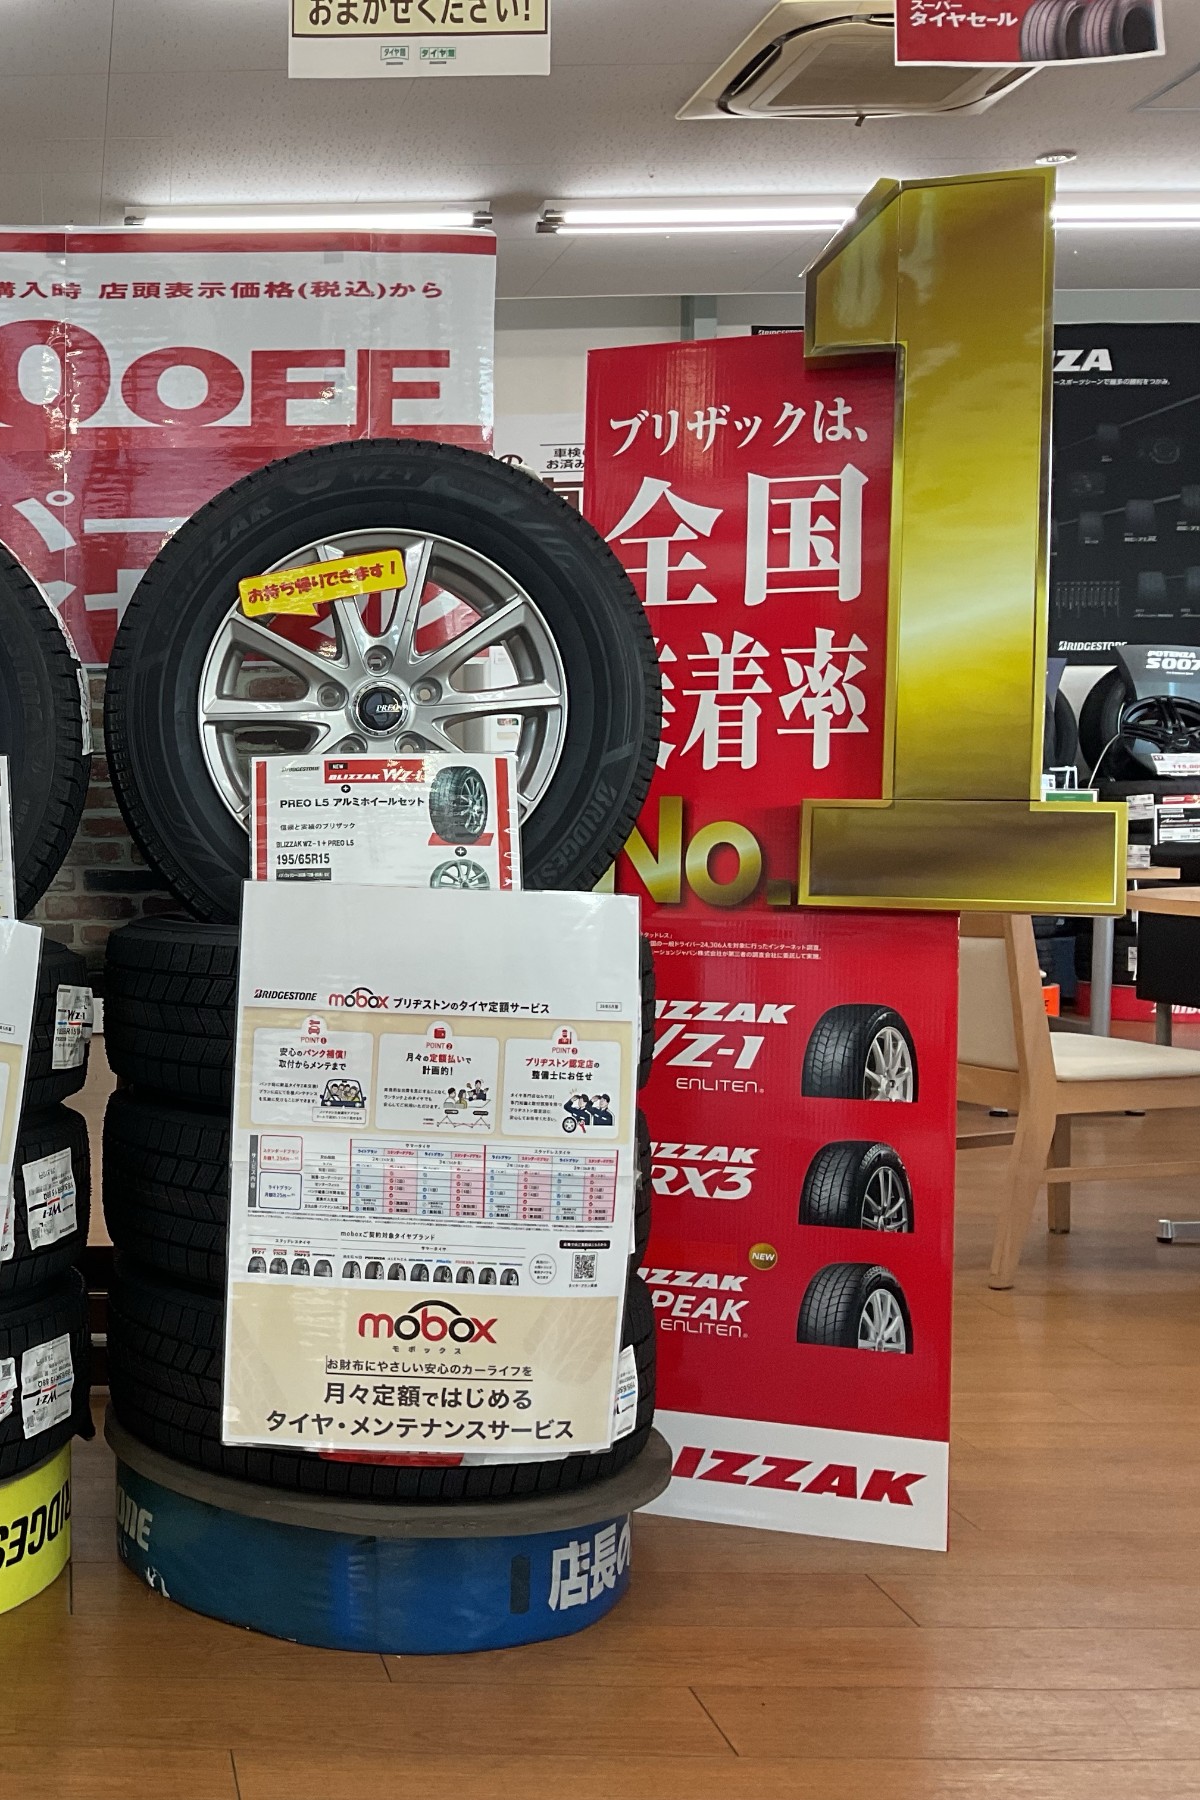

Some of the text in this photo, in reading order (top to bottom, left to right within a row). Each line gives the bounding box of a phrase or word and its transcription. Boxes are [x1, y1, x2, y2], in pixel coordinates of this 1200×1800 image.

[910, 12, 1018, 28] タイヤセール
[98, 279, 444, 300] 店頭表示価格(税込)から
[1053, 349, 1113, 371] ZA
[609, 396, 869, 457] ブリザックは、
[604, 463, 869, 607] 全国
[247, 561, 397, 605] お持ち帰りできます!
[1146, 658, 1200, 670] S007
[280, 797, 425, 809] PREO L5 アルミホイールセット
[276, 853, 330, 865] 195/65R15
[253, 988, 550, 1015] BRIDGESTONE mobox ブリヂストンのタイヤ定額サービス
[279, 1060, 346, 1070] 取付からメンテまで
[406, 1053, 471, 1064] 月々の定額払いで
[525, 1058, 599, 1069] ブリヂストン認定店の
[422, 1065, 453, 1075] 計画的!
[532, 1071, 593, 1081] 整備士にお任せ
[676, 1078, 757, 1094] ENLITEN
[751, 1252, 776, 1261] NEW
[651, 1290, 750, 1323] PEAK
[358, 1303, 498, 1344] mobox
[661, 1319, 742, 1337] ENLITEN
[391, 1345, 462, 1355] モボックス
[326, 1359, 533, 1377] お財布にやさしい安心のカーライフを
[323, 1382, 533, 1410] 月々定額ではじめる
[266, 1410, 574, 1440] タイヤ・メンテナンスサービス
[671, 1446, 927, 1506] IZZAK
